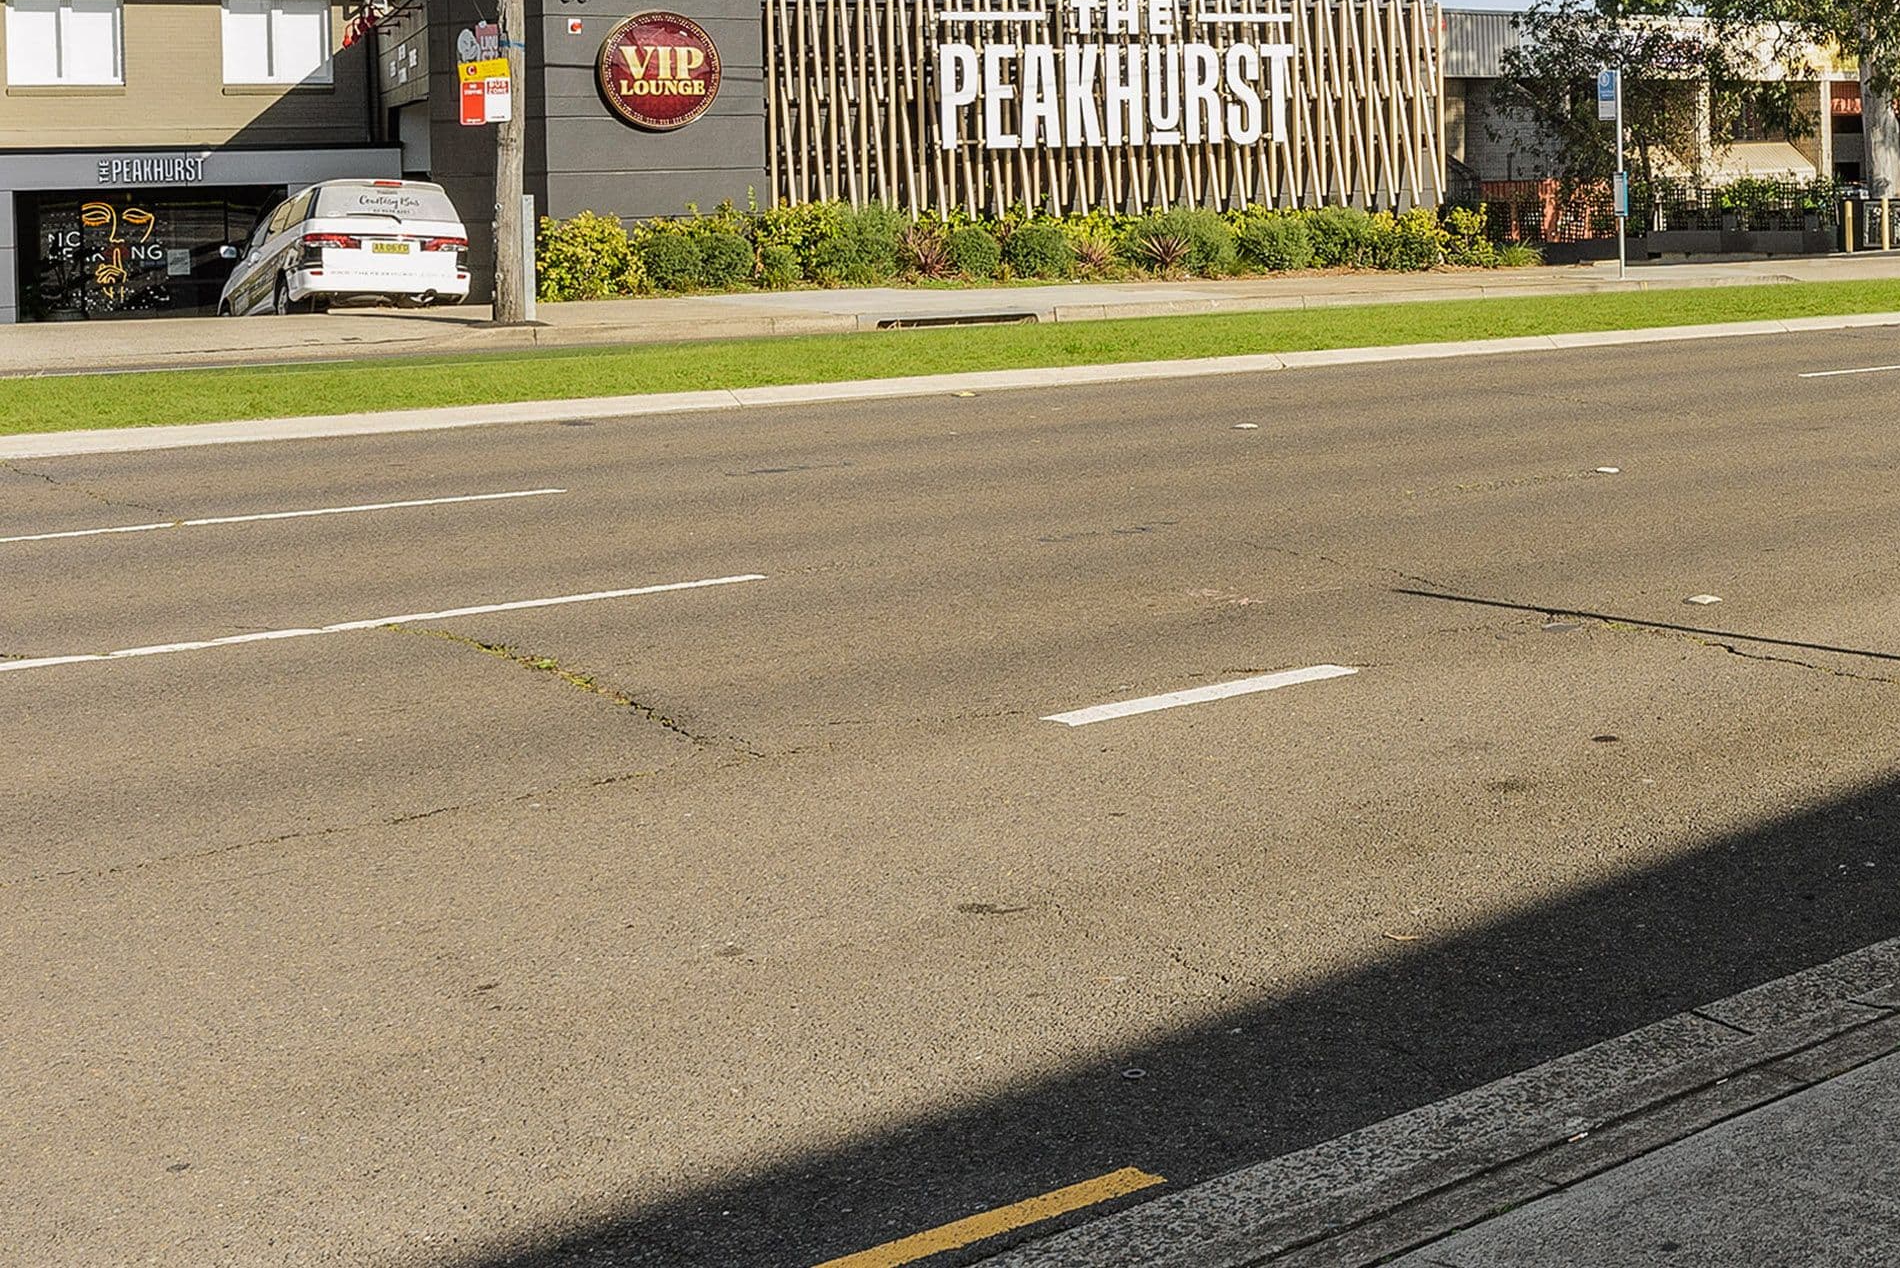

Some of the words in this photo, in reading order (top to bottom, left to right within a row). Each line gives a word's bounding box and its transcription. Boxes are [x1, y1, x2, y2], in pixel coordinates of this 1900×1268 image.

[619, 45, 705, 80] VIP
[619, 79, 706, 96] LOUNGE
[938, 43, 1295, 150] PEAKHURST
[99, 159, 109, 184] THE
[112, 157, 205, 183] PEAKHURST
[400, 197, 421, 207] Bus
